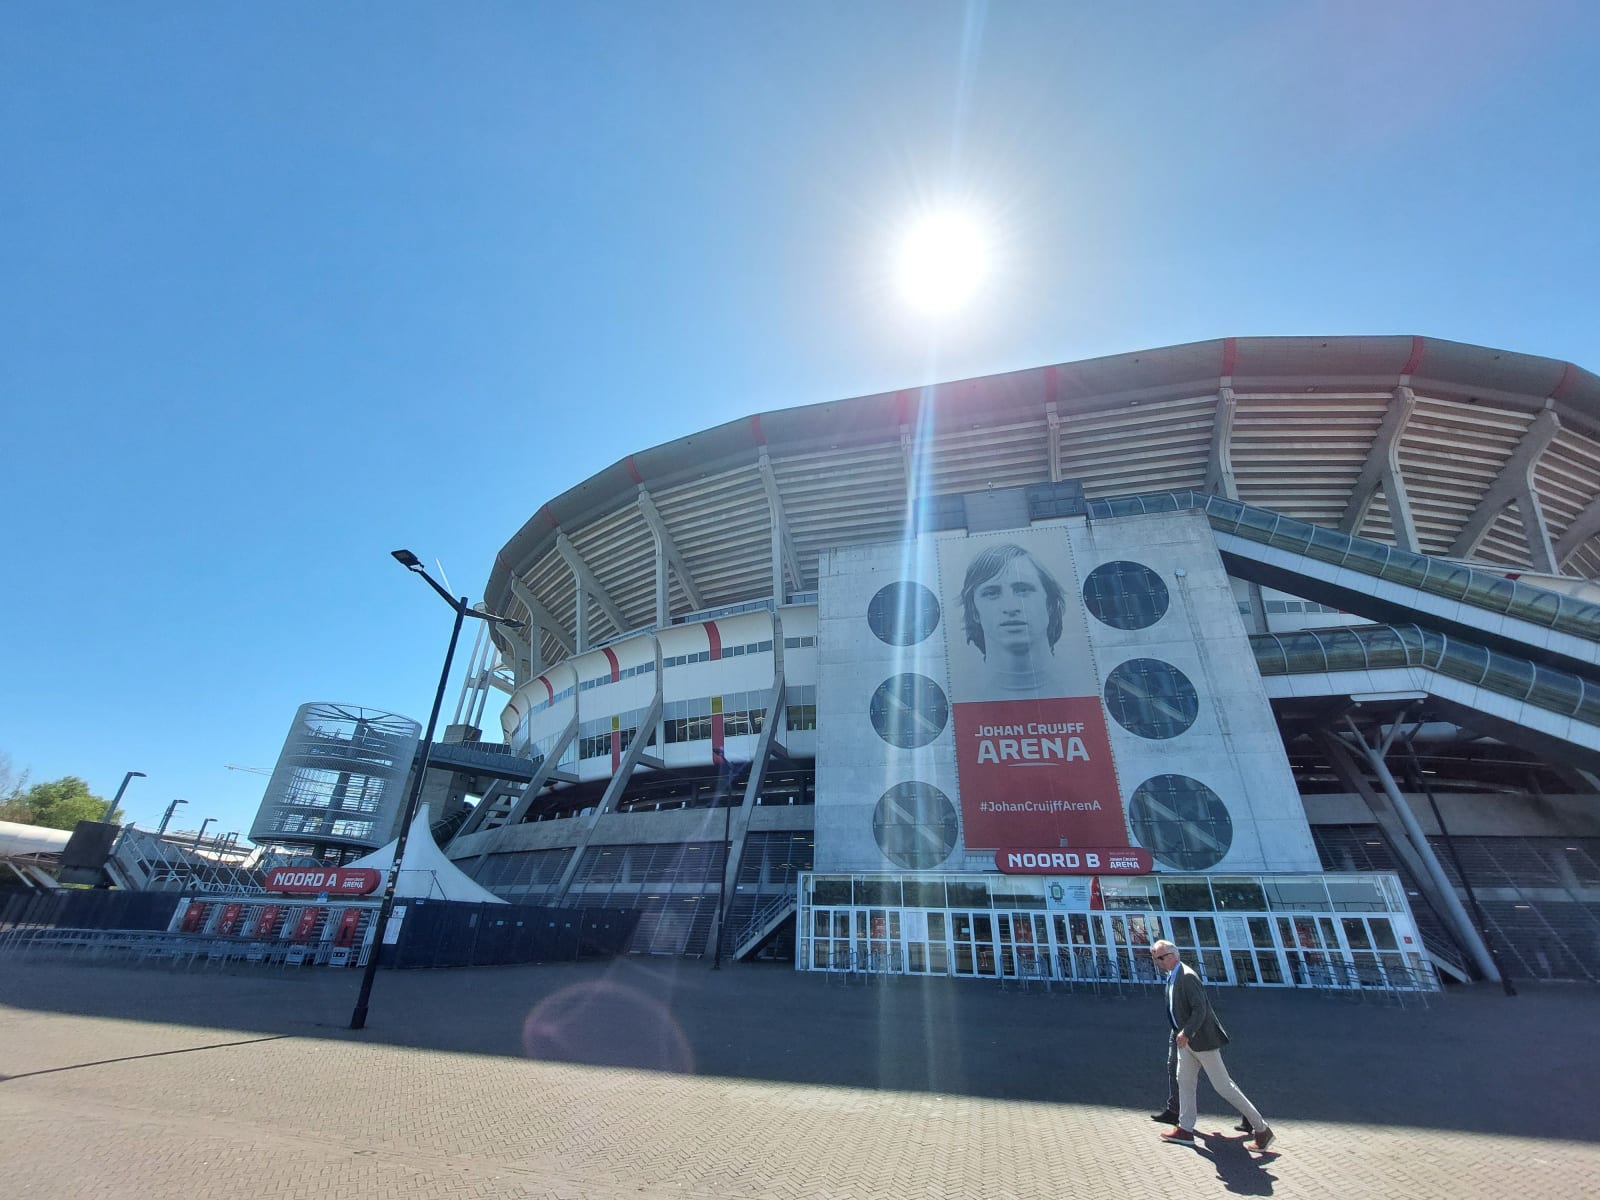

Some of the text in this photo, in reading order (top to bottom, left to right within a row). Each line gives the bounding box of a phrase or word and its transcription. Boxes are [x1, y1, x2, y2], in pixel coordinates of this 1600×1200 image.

[975, 725, 1024, 737] JOHAN
[977, 737, 1090, 764] ARENA
[979, 799, 1102, 814] #JohanCruijffArenA
[1008, 853, 1100, 867] NOORD B
[1110, 861, 1140, 869] ARENA
[273, 873, 337, 887] NOORD A
